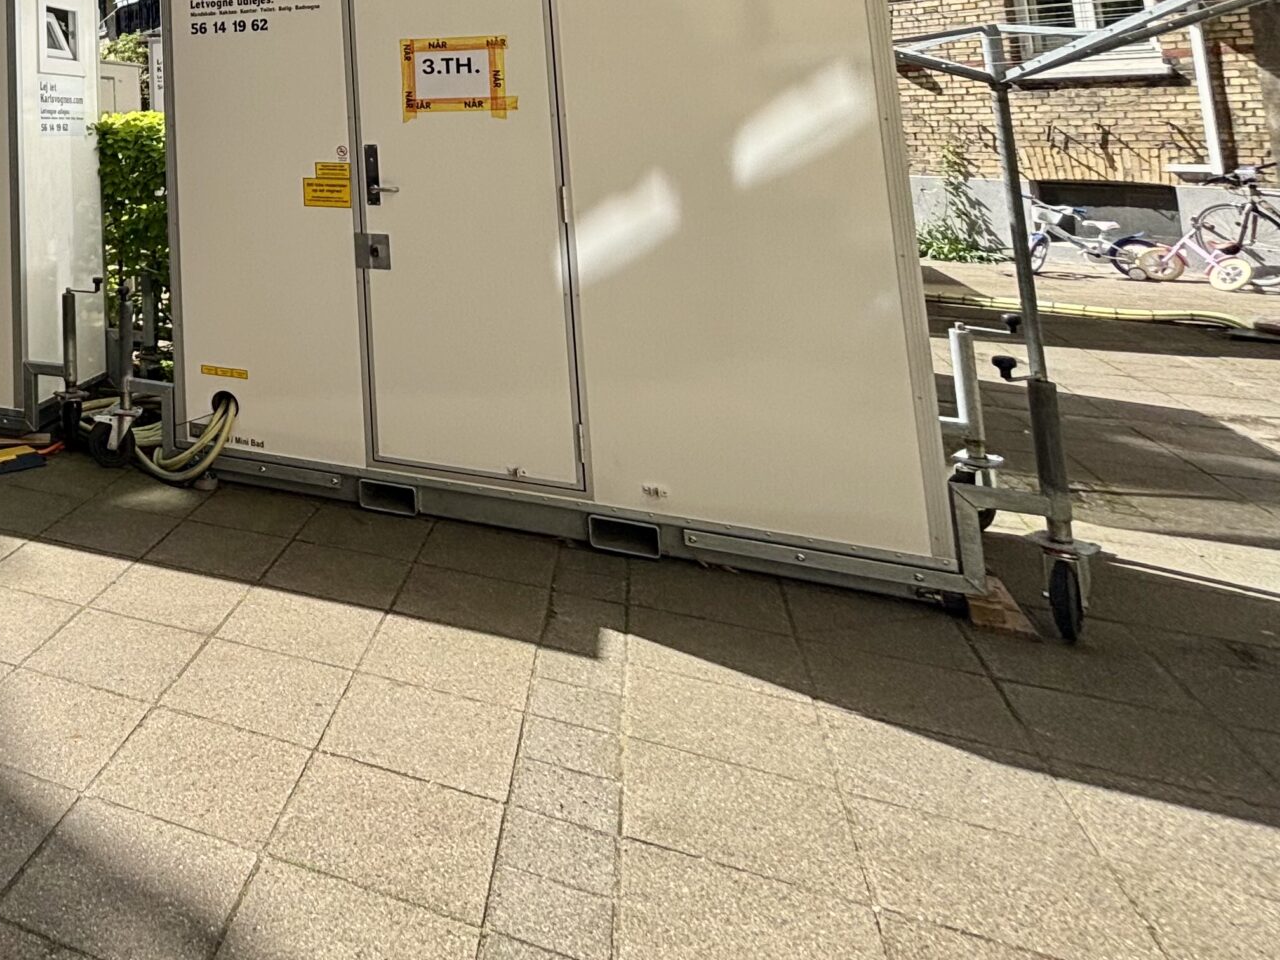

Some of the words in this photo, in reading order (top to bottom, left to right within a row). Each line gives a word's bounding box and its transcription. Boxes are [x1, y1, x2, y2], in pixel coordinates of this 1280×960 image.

[191, 22, 207, 34] 56
[213, 21, 226, 33] 14
[232, 20, 246, 32] 19
[251, 19, 268, 31] 62
[428, 38, 448, 49] NÅR
[422, 57, 481, 75] 3.TH.
[464, 98, 484, 109] NÅR
[250, 438, 265, 448] Bad
